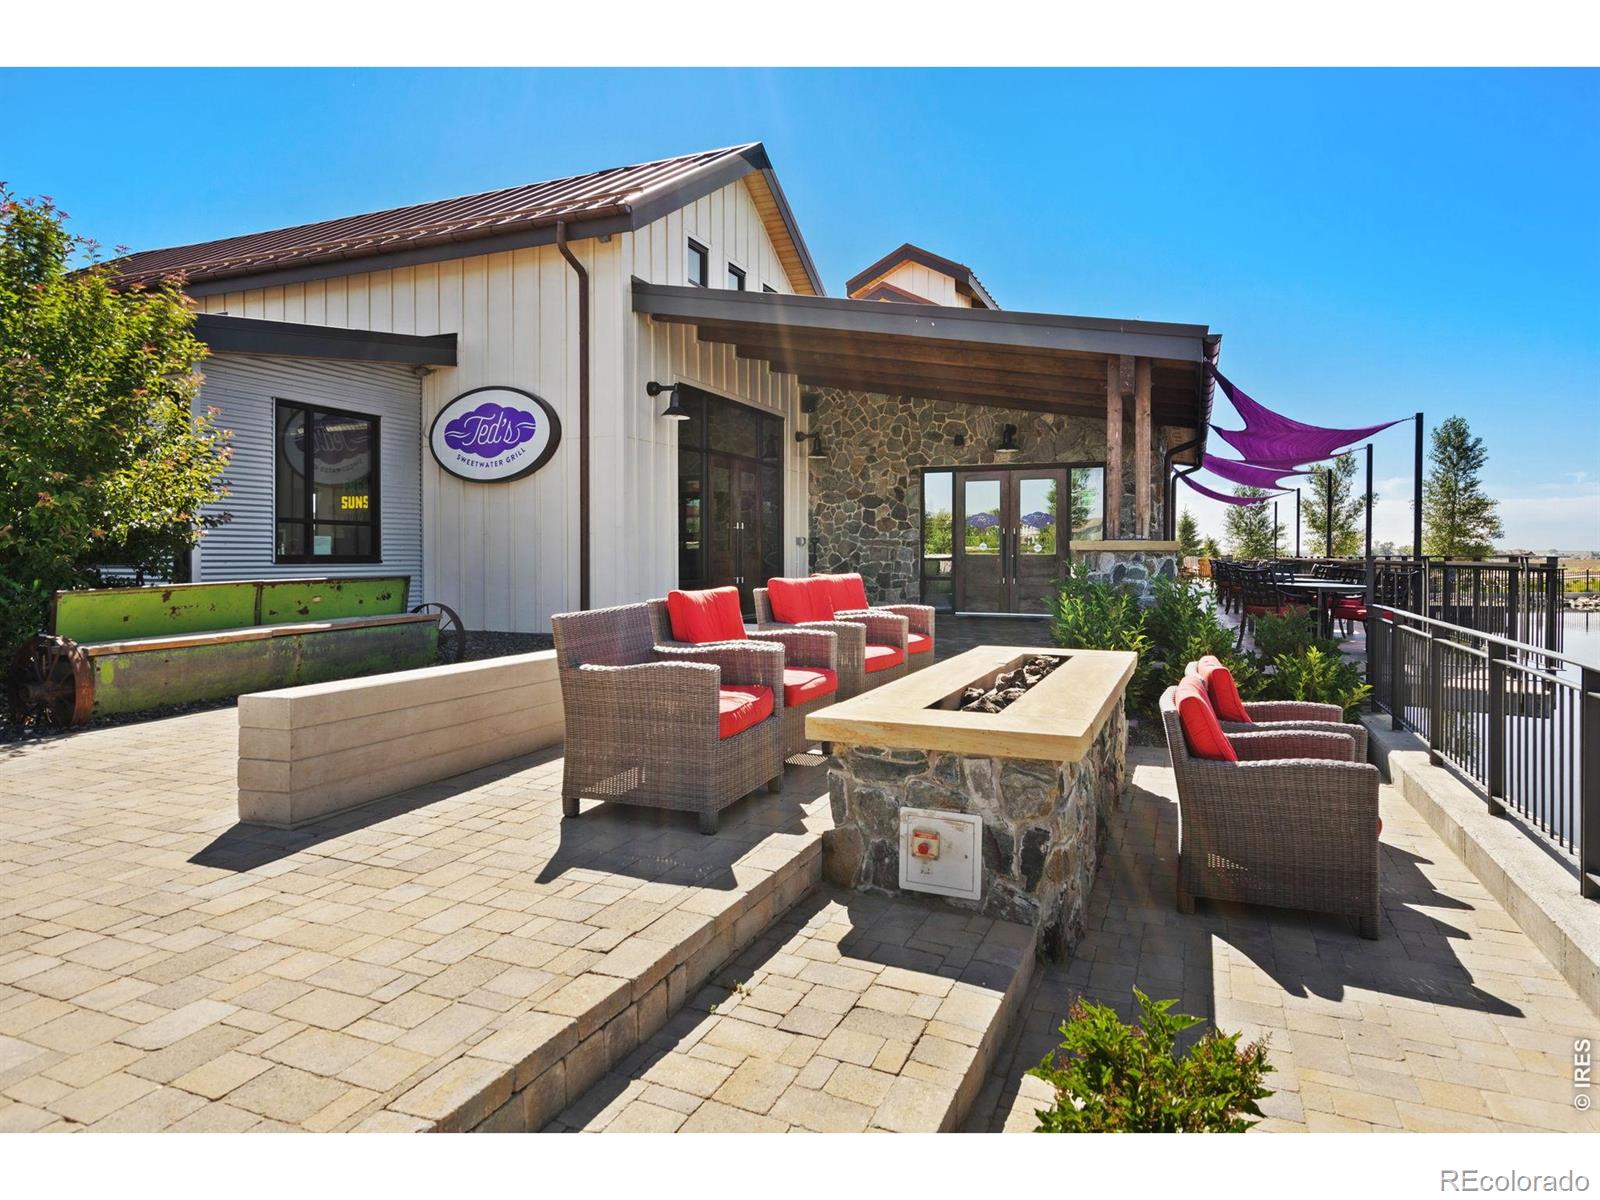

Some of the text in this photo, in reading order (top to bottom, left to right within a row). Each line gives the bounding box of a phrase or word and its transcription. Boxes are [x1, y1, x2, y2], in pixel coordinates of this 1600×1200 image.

[461, 411, 521, 446] Ted's
[456, 447, 527, 468] SWEETWATER GRILL
